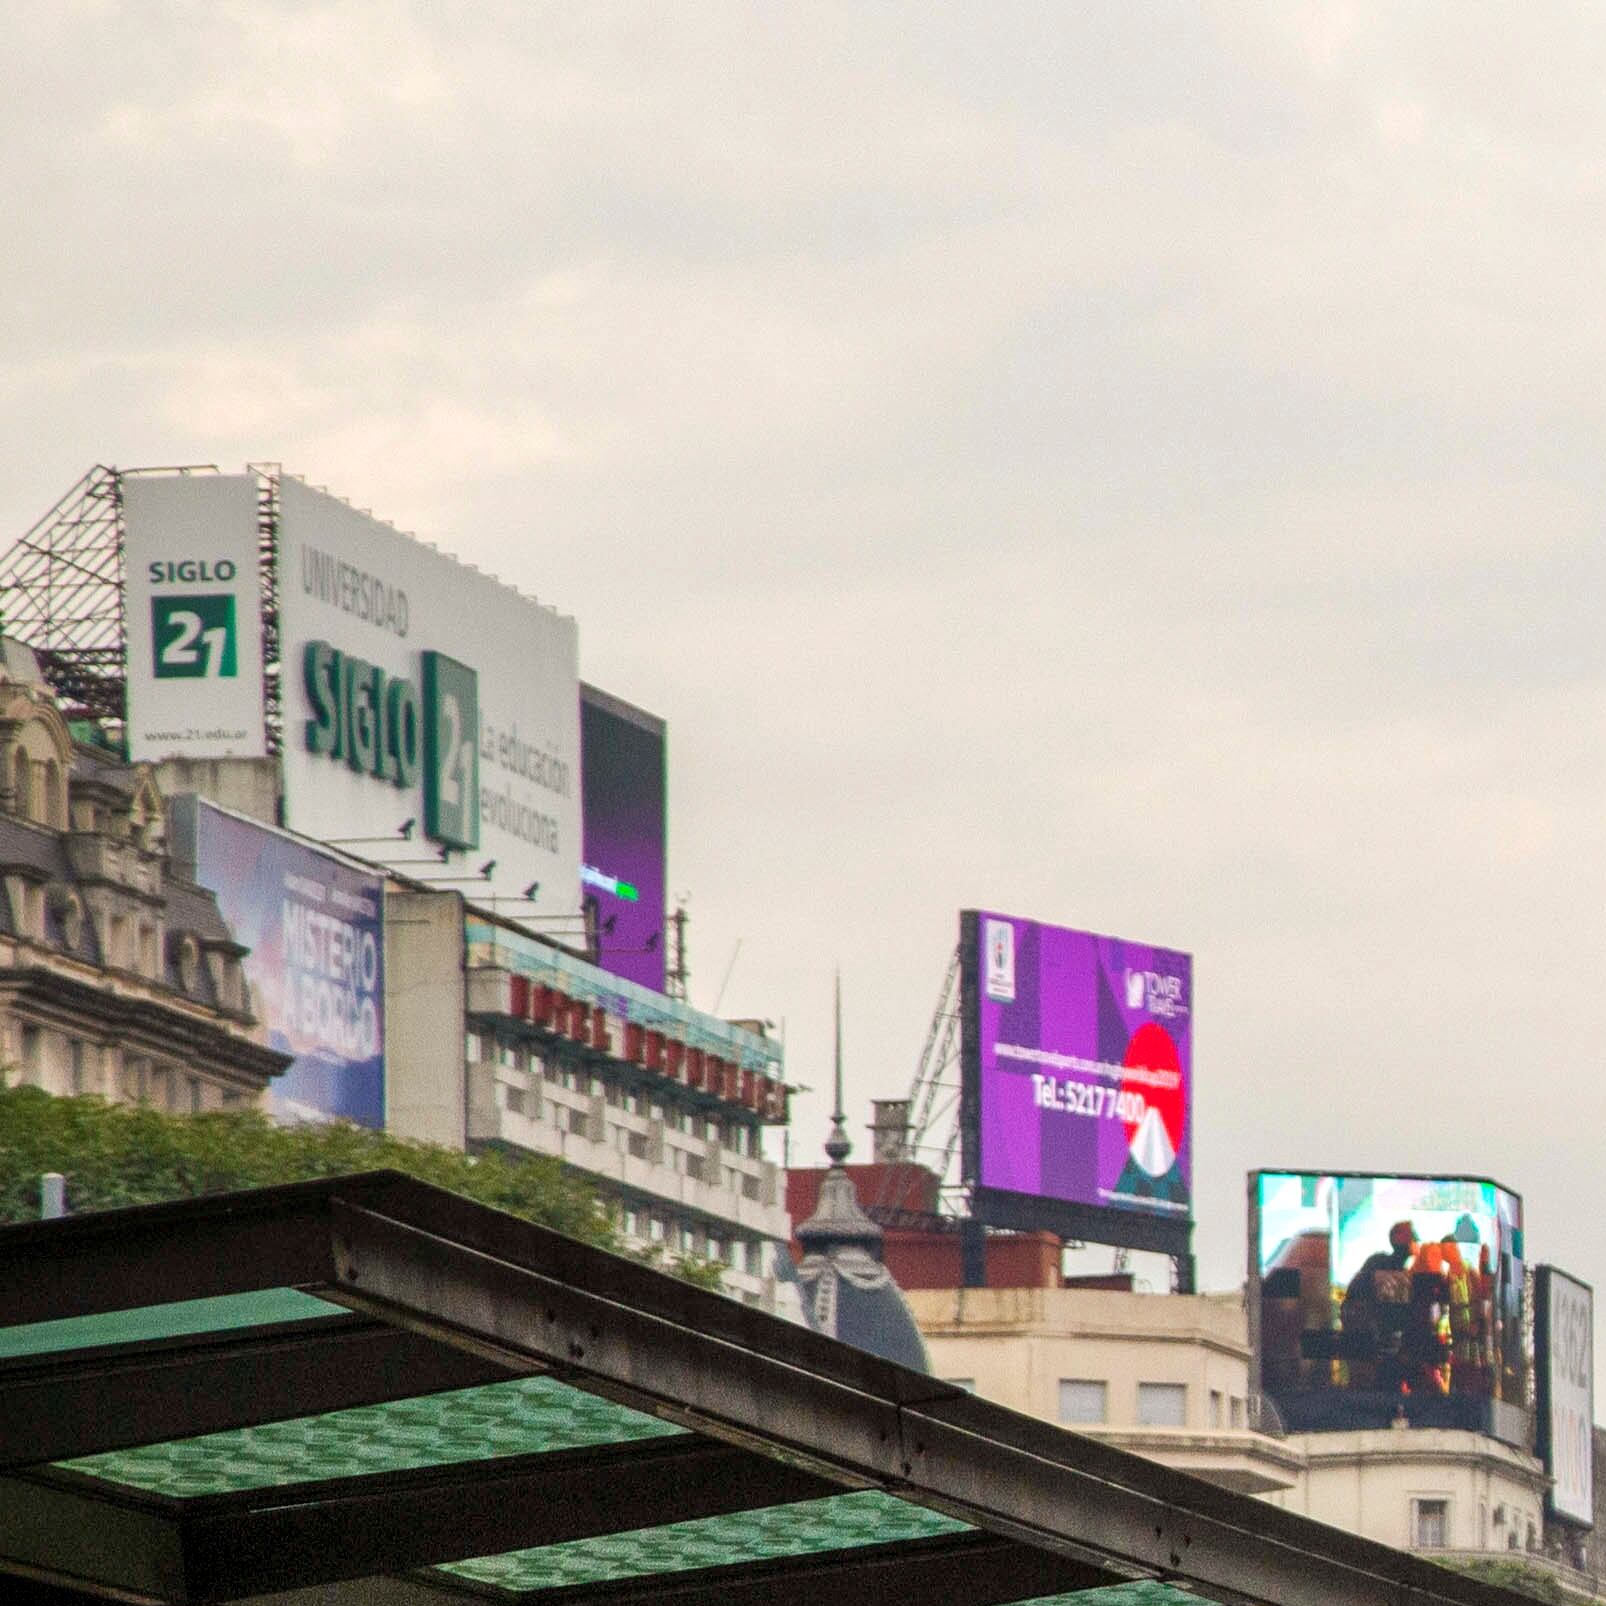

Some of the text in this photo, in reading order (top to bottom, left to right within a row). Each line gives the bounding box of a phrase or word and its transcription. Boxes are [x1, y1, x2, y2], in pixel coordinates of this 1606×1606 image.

[149, 560, 236, 583] SIGLO
[302, 543, 409, 638] UNIVERSIDAD
[162, 610, 226, 677] 21
[303, 639, 417, 789] SIGLO
[284, 898, 376, 990] MISTERIO
[1144, 970, 1182, 1000] TOWER
